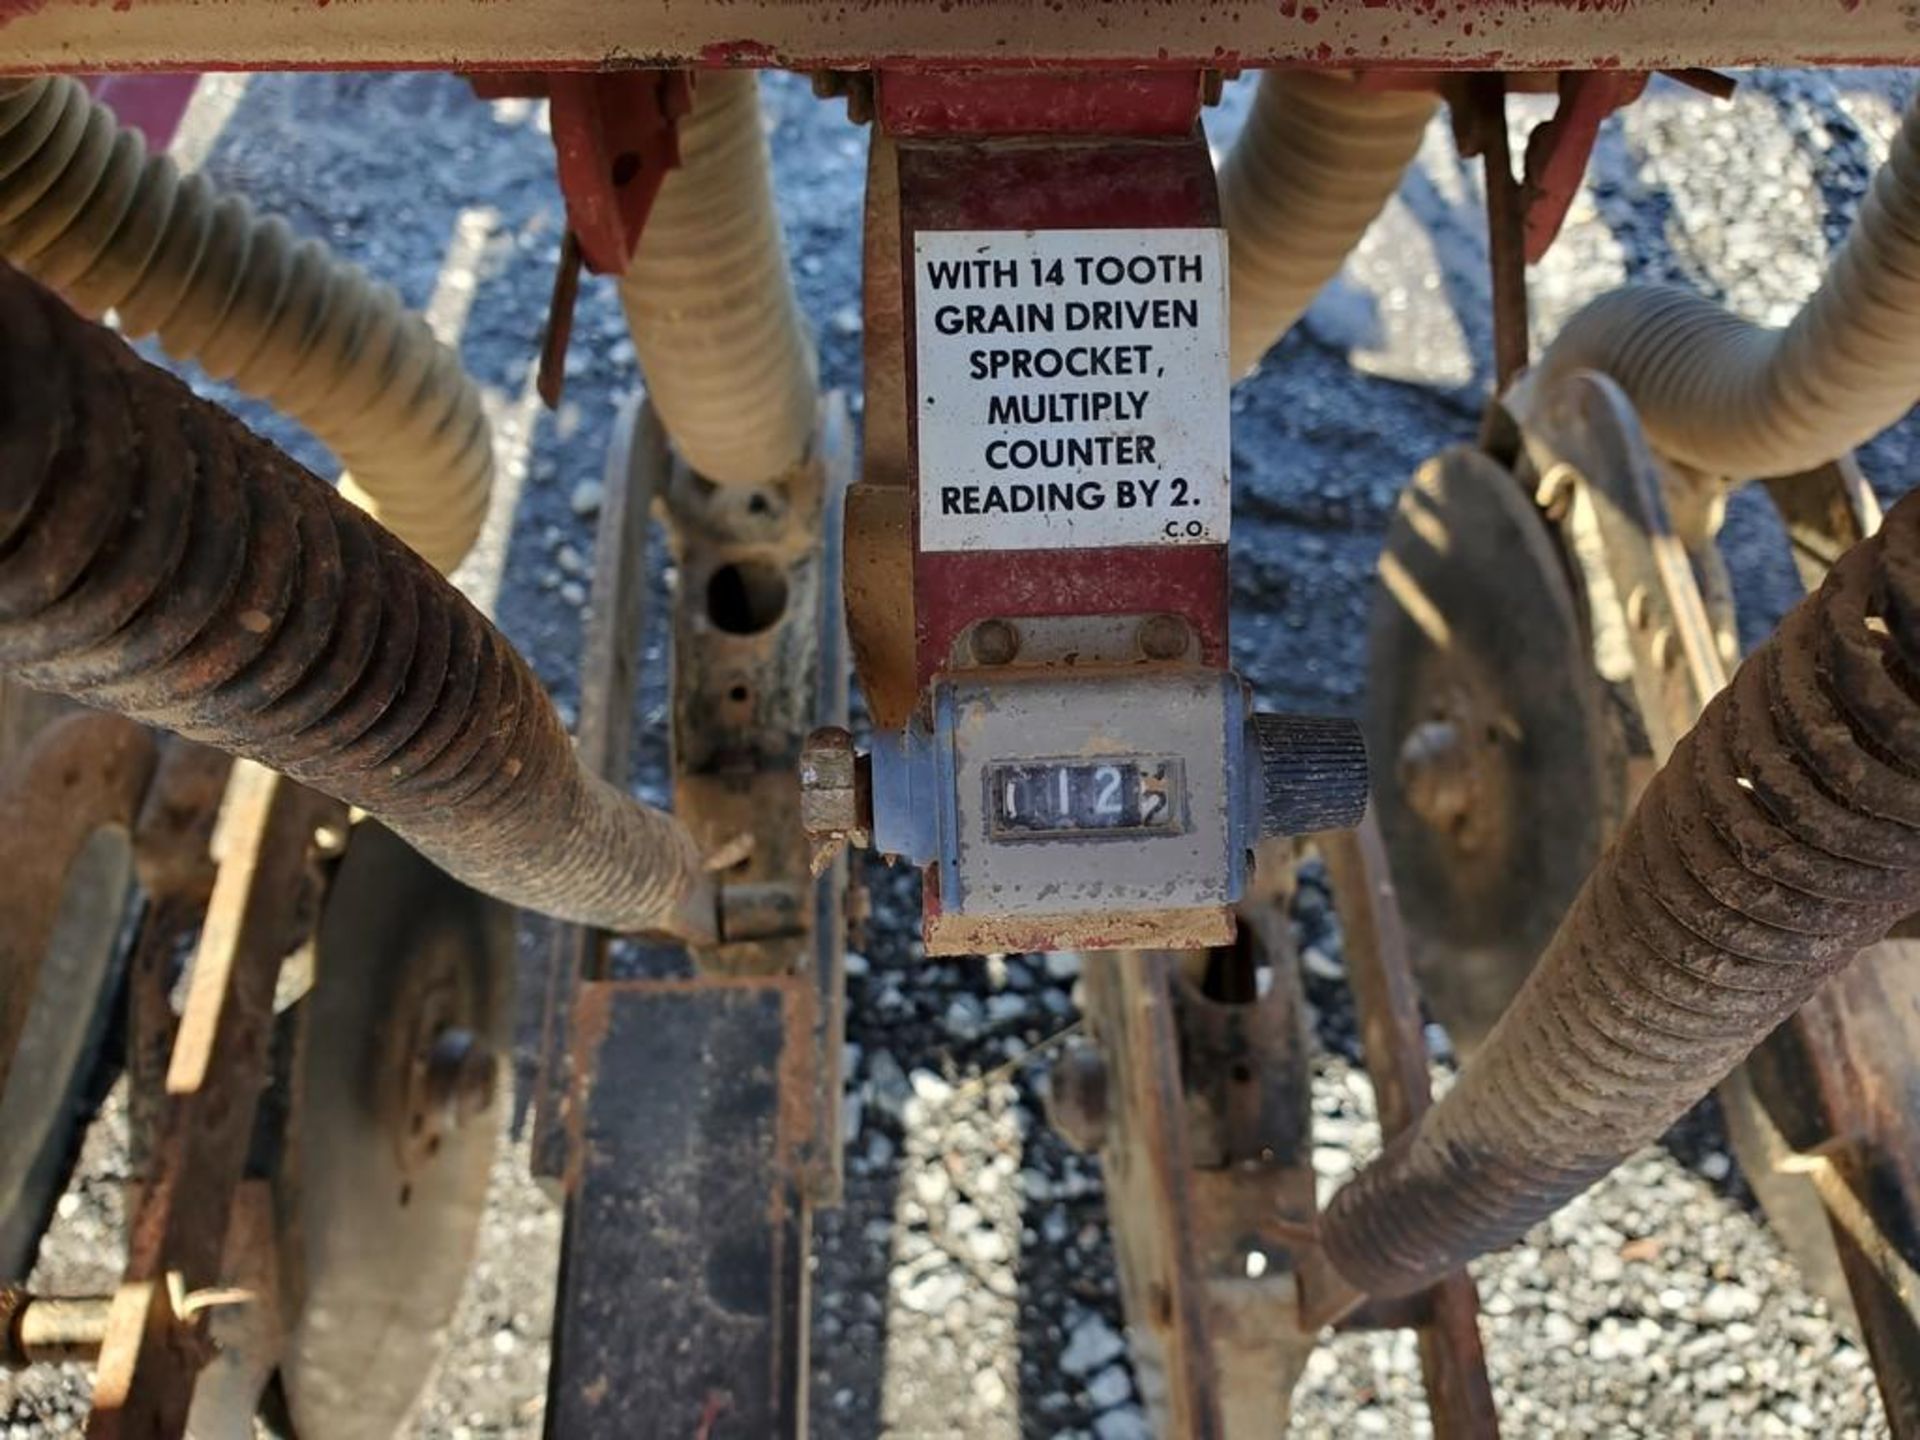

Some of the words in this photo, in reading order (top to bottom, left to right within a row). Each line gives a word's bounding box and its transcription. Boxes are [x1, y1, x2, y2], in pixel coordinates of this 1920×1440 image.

[927, 259, 1018, 290] WITH
[1031, 258, 1065, 288] 14
[1074, 255, 1203, 286] TOOTH
[935, 303, 1054, 335] GRAIN
[1065, 299, 1198, 331] DRIVEN
[969, 345, 1164, 380] SPROCKET,
[988, 391, 1149, 424] MULTIPLY
[985, 435, 1156, 470] COUNTER
[941, 481, 1105, 515] READING
[1117, 479, 1160, 508] BY
[1170, 477, 1200, 507] 2.
